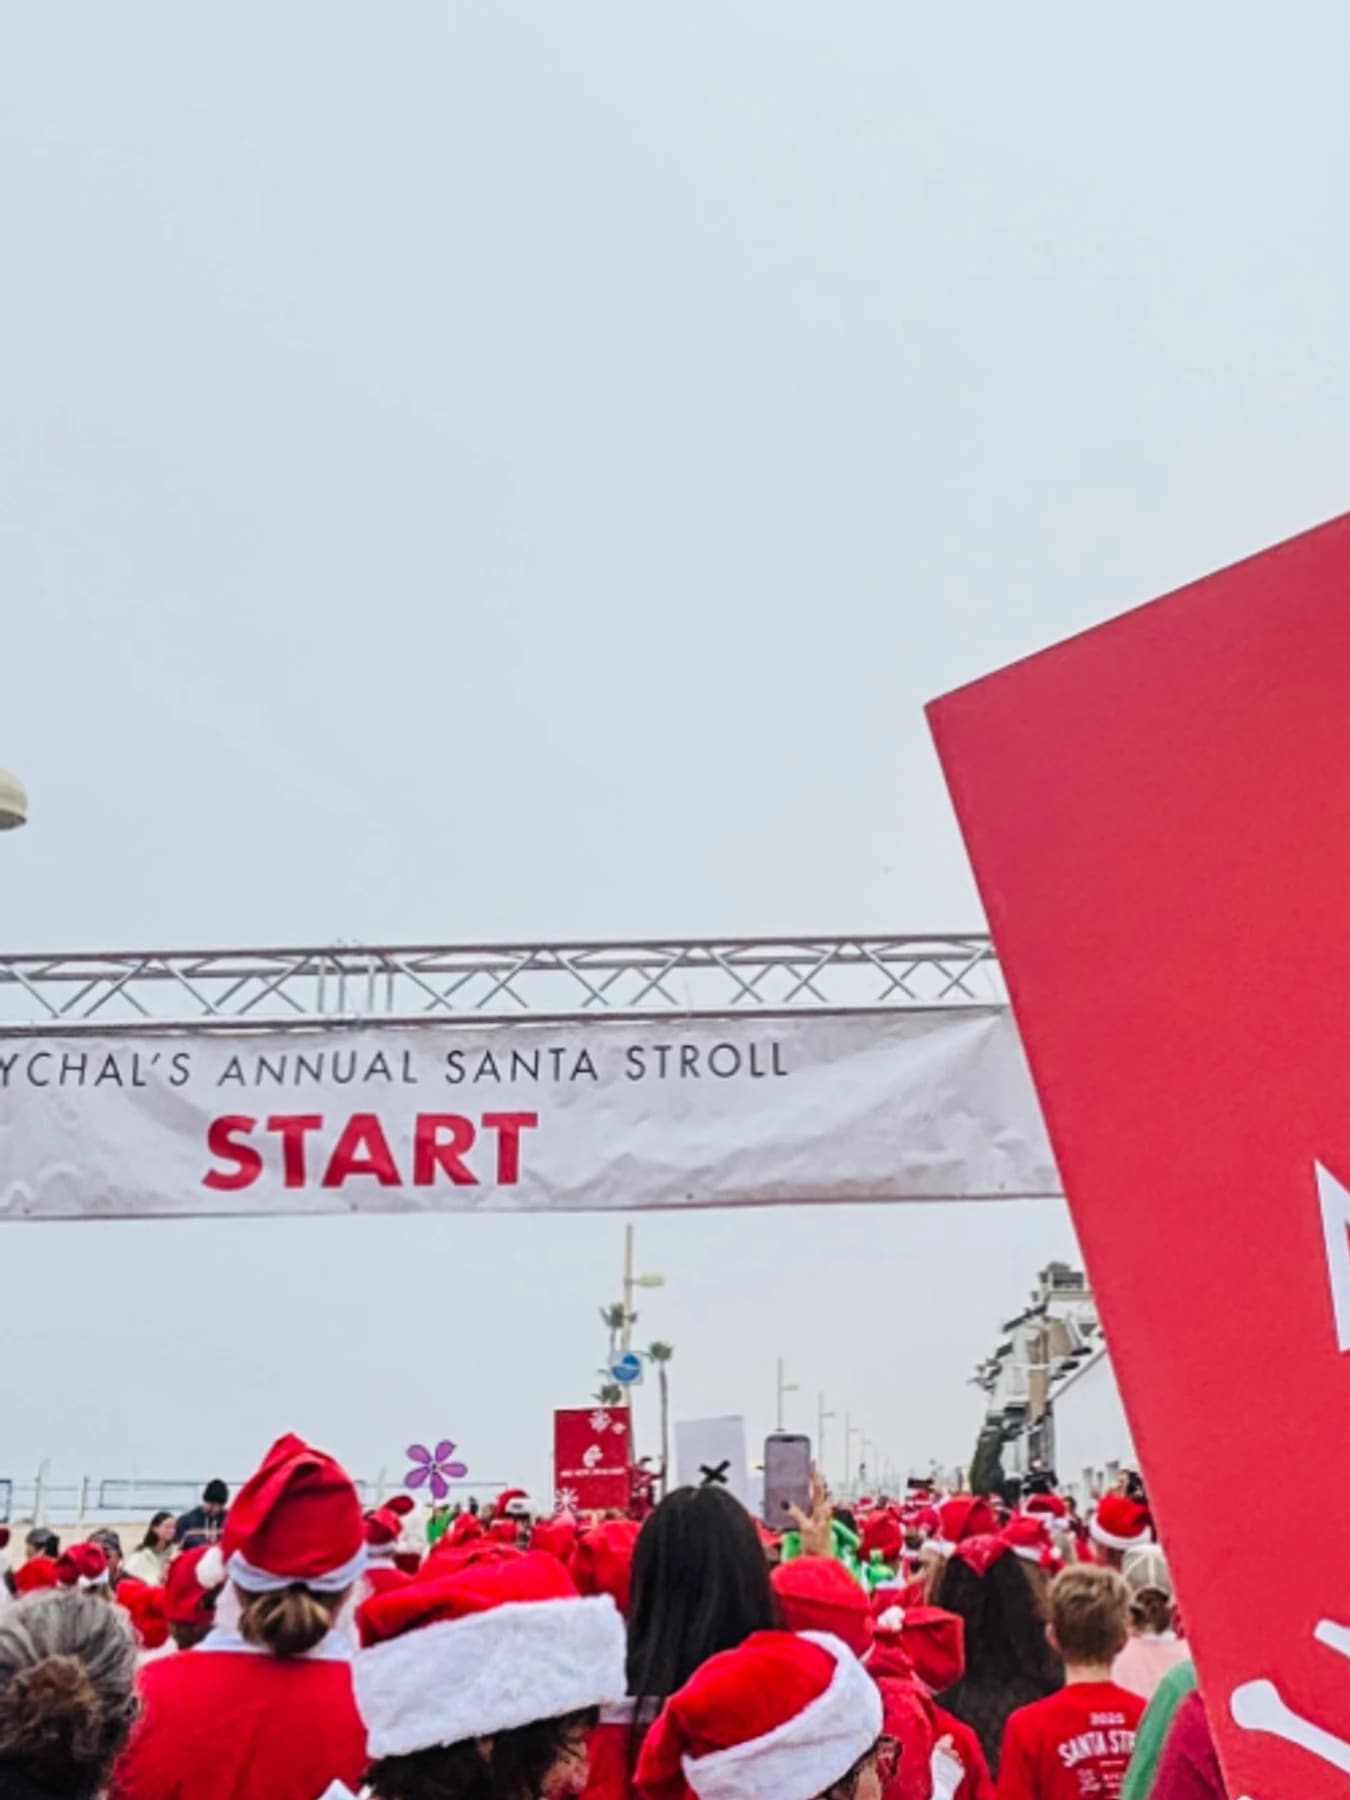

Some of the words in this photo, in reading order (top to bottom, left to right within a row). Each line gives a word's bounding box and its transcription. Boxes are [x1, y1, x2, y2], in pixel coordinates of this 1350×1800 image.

[0, 1051, 191, 1087] YCHAL'S
[217, 1050, 417, 1086] ANNUAL
[445, 1047, 599, 1084] SANTA
[625, 1042, 788, 1081] STROLL
[202, 1112, 538, 1191] START
